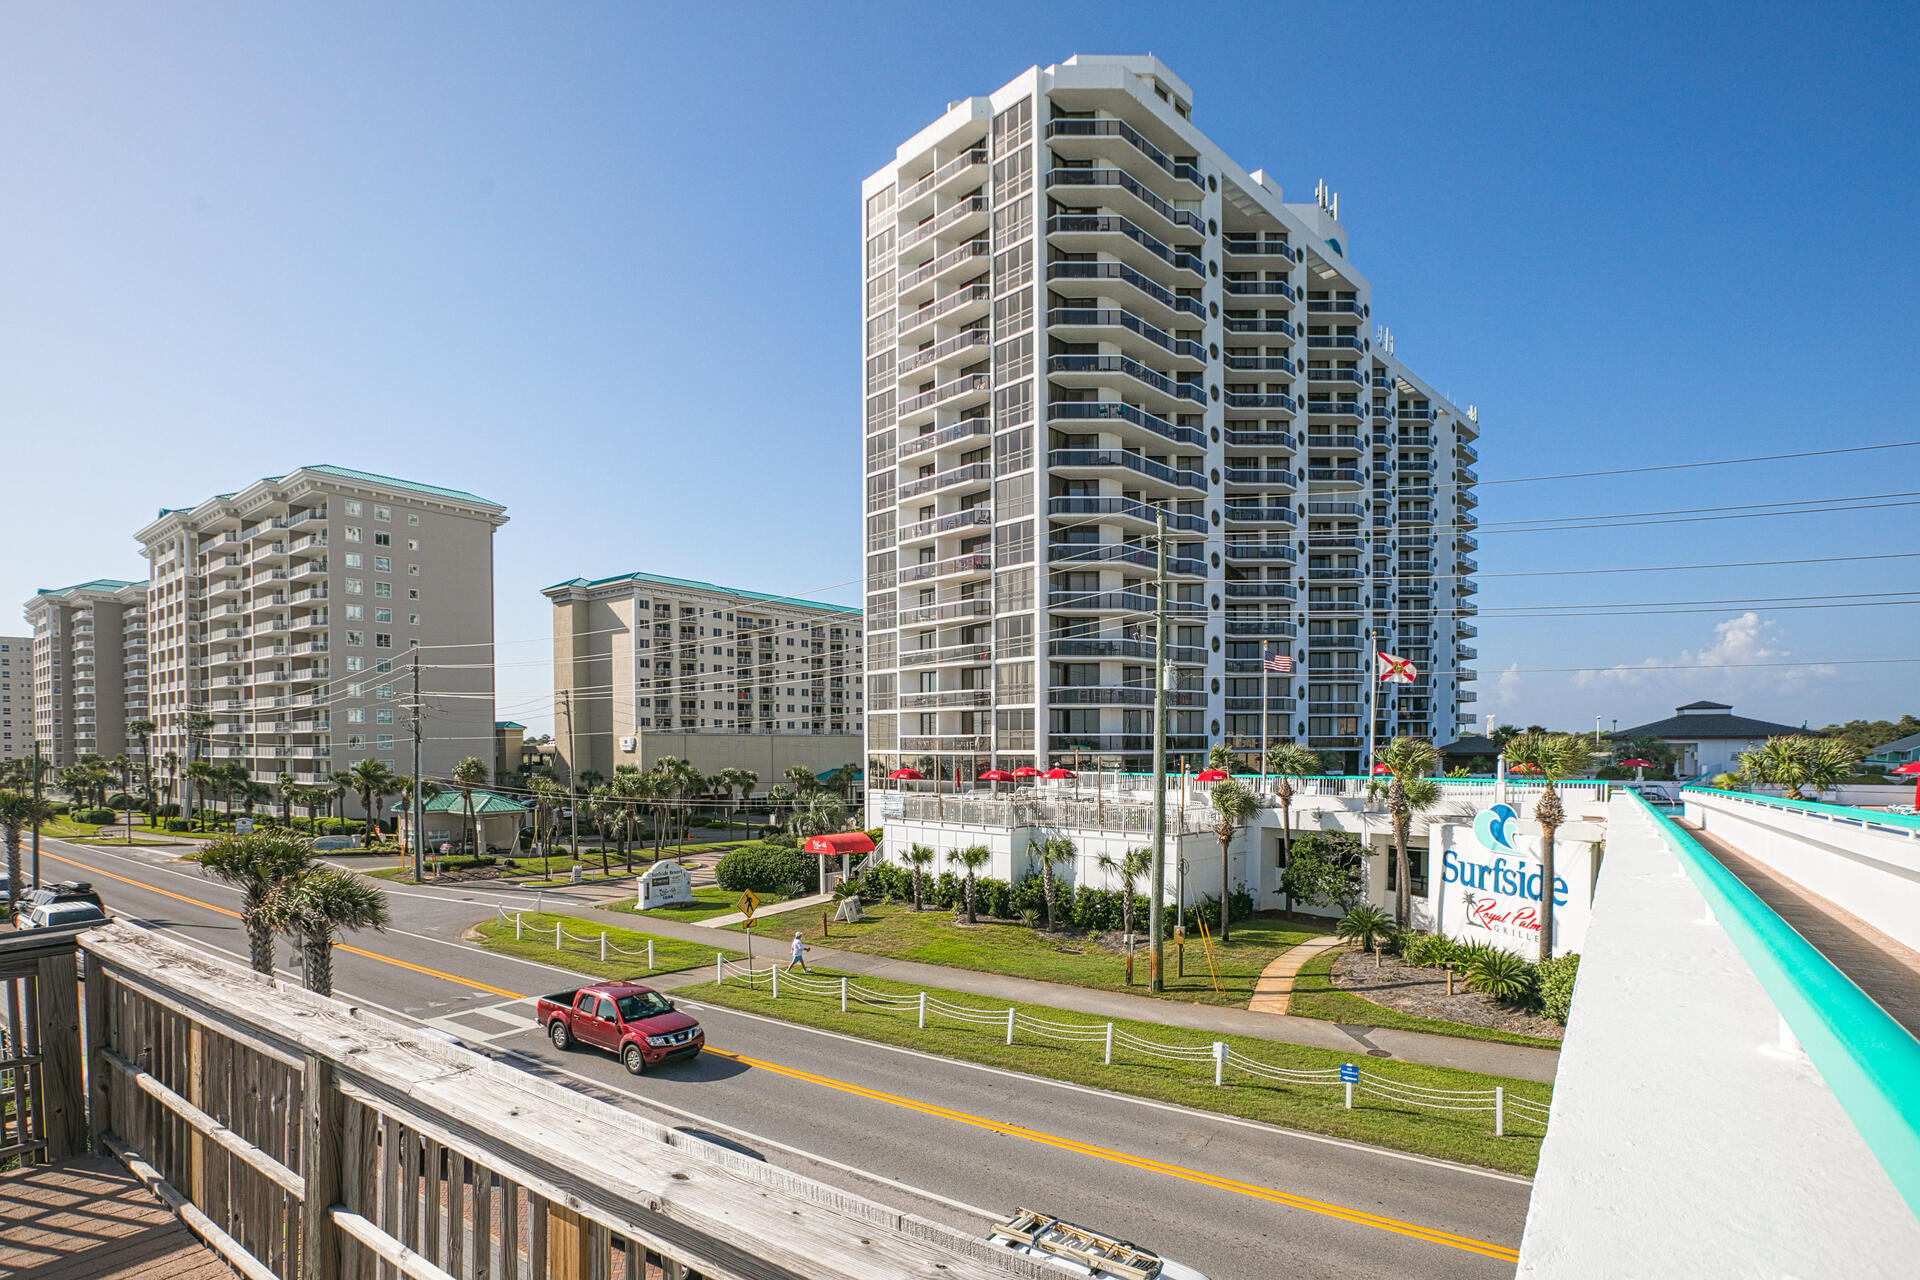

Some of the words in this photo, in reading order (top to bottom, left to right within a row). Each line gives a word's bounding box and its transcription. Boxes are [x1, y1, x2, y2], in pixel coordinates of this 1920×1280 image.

[1442, 850, 1568, 907] Surfside
[1473, 898, 1511, 931] Royal
[1511, 906, 1541, 932] Palm
[1493, 924, 1540, 943] GRILLE
